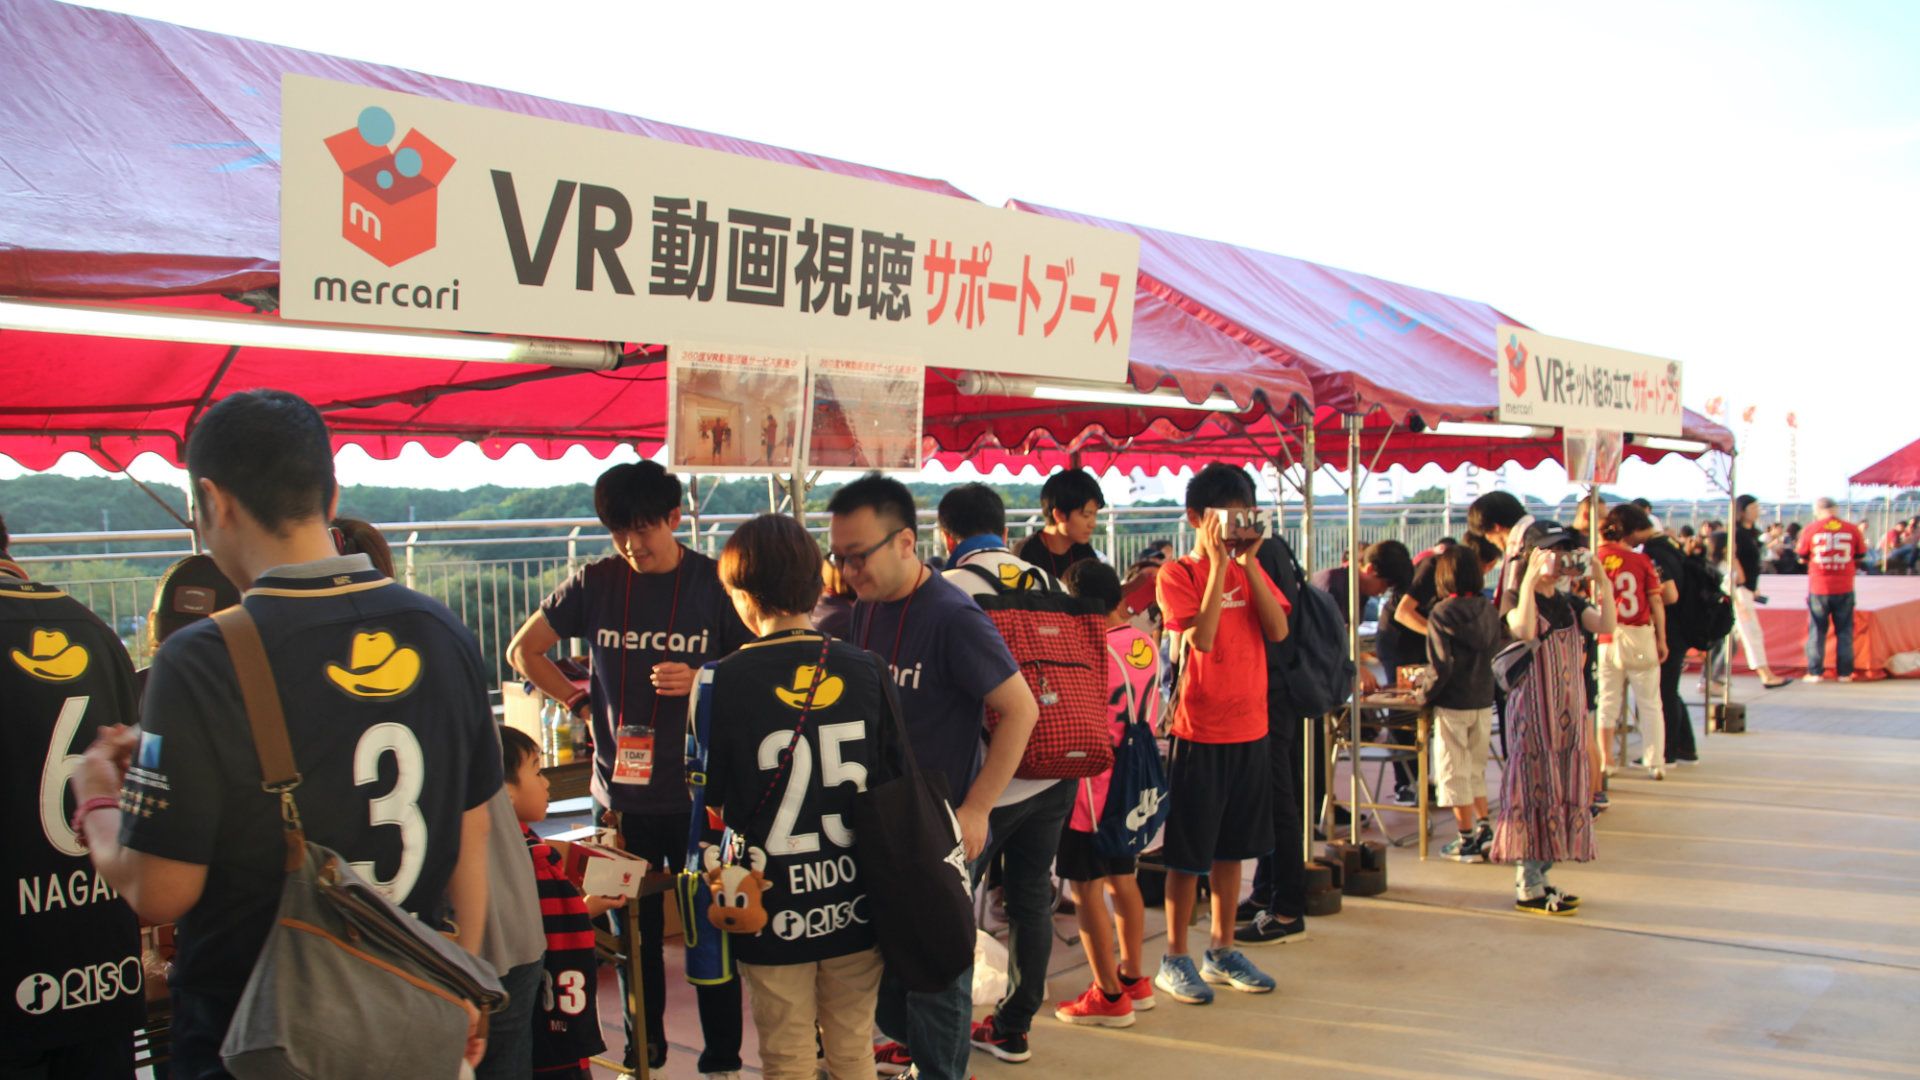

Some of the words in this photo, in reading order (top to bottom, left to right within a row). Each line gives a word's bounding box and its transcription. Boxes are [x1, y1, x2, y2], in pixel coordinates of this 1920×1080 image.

[349, 201, 382, 241] m
[314, 276, 460, 311] mercari
[1505, 402, 1534, 416] mercari
[1812, 532, 1853, 564] 25
[597, 628, 709, 654] mercari
[39, 695, 91, 858] 6
[757, 719, 869, 856] 25
[349, 721, 428, 907] 3
[18, 869, 119, 916] NAGA
[788, 854, 857, 895] ENDO
[61, 955, 142, 1010] RISO
